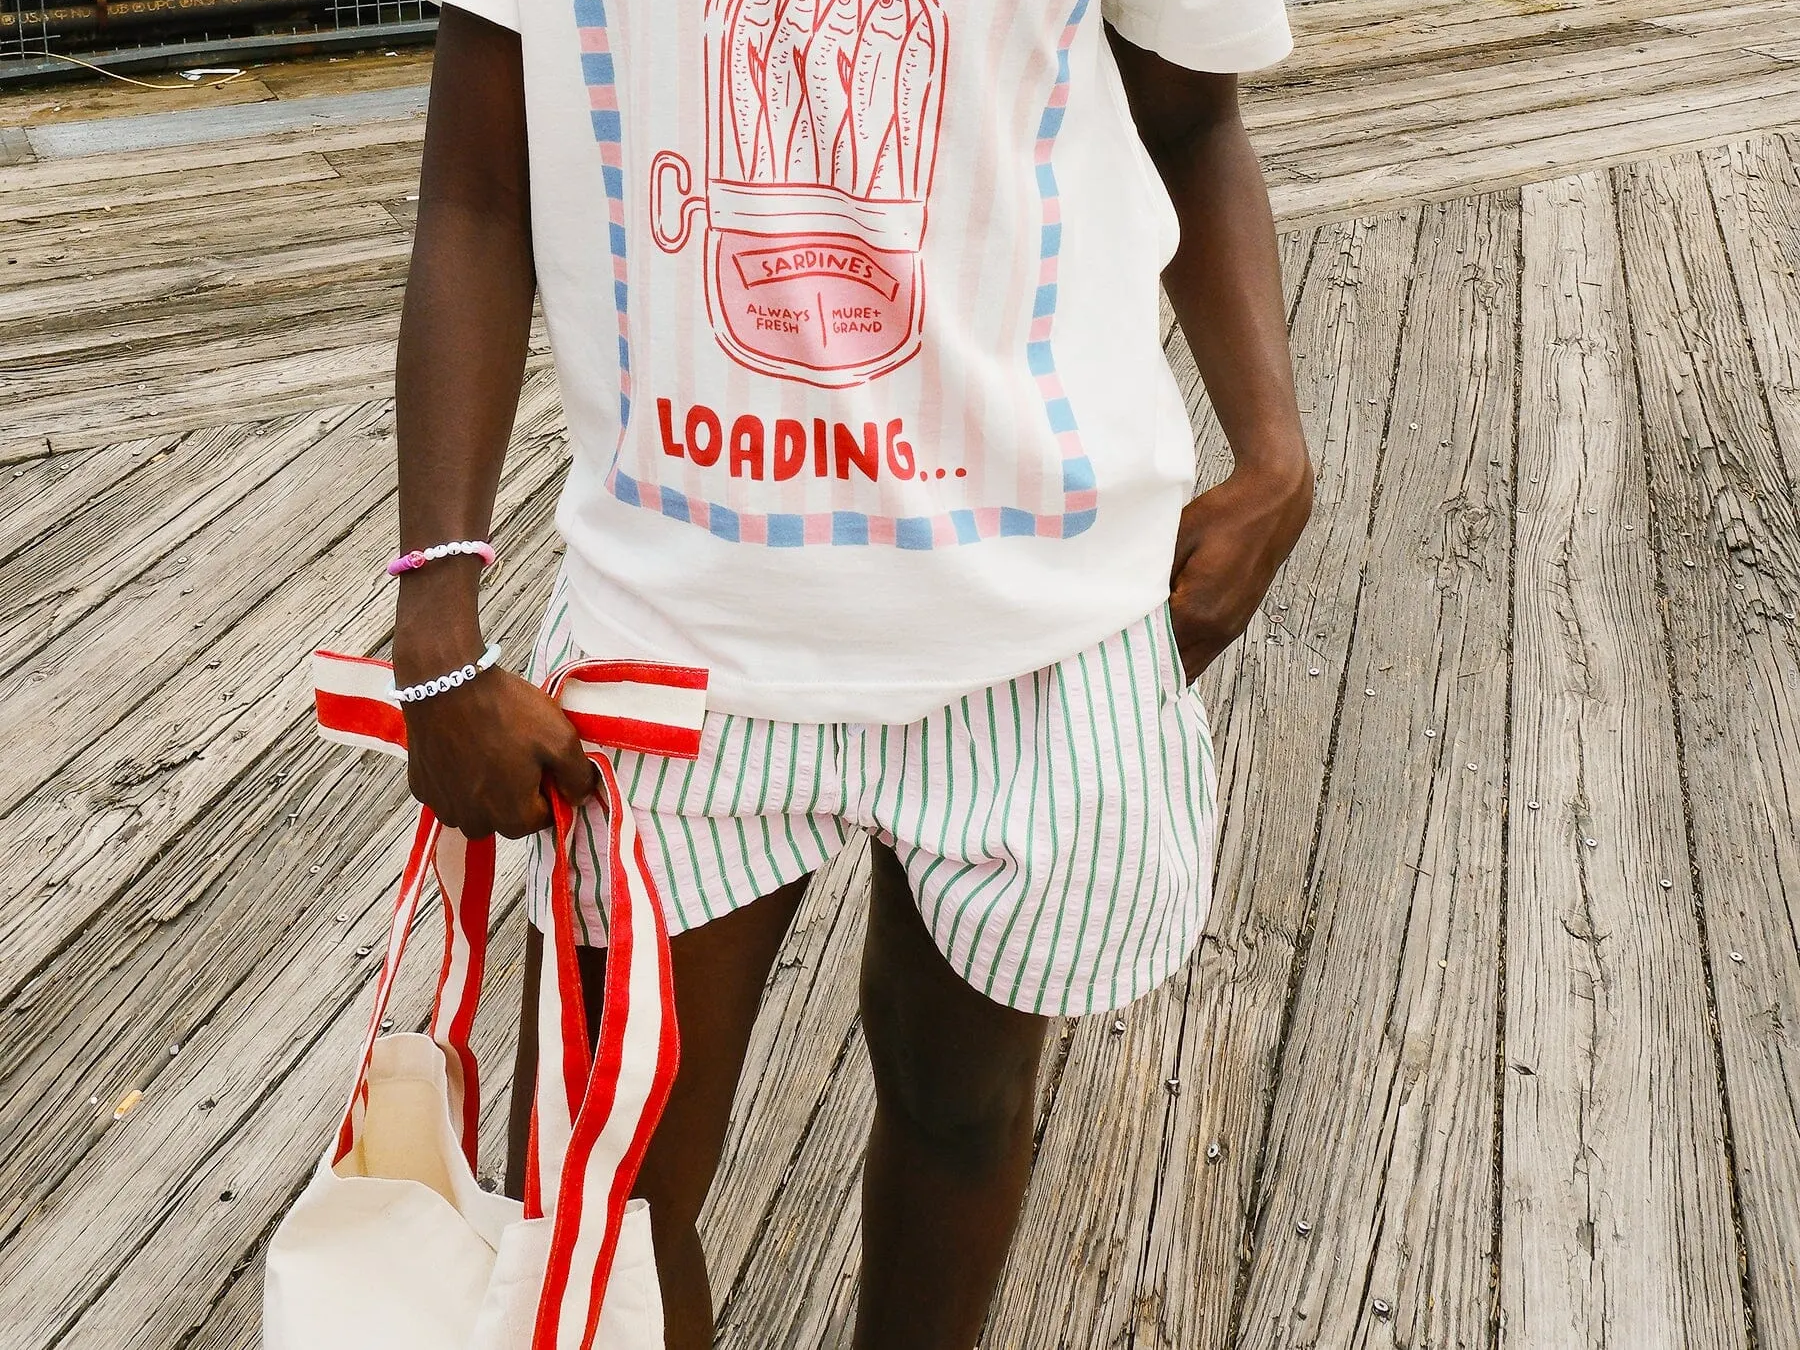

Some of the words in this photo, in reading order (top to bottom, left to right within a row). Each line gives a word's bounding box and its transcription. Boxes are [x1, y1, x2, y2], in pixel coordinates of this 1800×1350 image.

[762, 250, 873, 279] SARDINES
[747, 303, 810, 322] ALWAYS
[832, 307, 881, 319] MURE+
[756, 317, 799, 334] FRESH
[832, 321, 882, 334] GRAND
[657, 398, 966, 481] LOADING...
